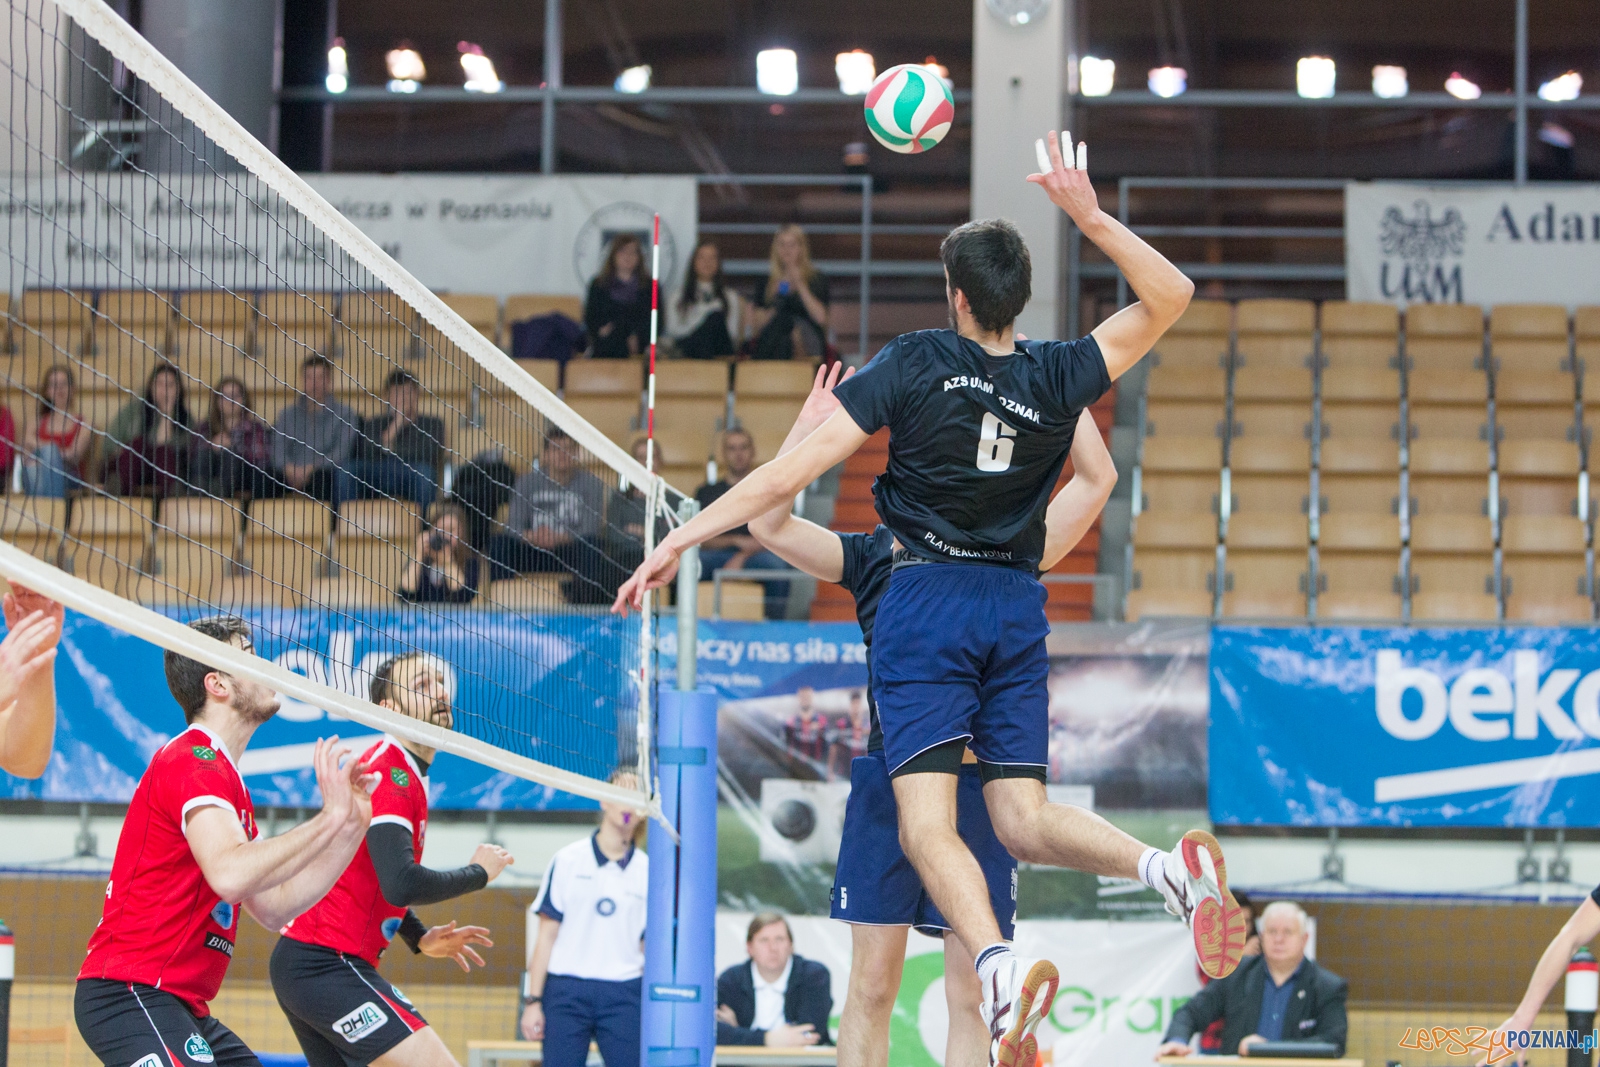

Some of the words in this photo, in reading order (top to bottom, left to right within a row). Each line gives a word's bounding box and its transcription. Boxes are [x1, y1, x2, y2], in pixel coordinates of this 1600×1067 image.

[944, 376, 968, 392] AZS
[970, 377, 994, 394] UAM
[998, 394, 1040, 424] OZNAŃ
[976, 411, 1017, 472] 6
[924, 531, 950, 553] PLAY
[949, 546, 981, 557] BEACH
[747, 641, 791, 663] nas
[793, 636, 838, 664] siła
[840, 886, 848, 910] 5
